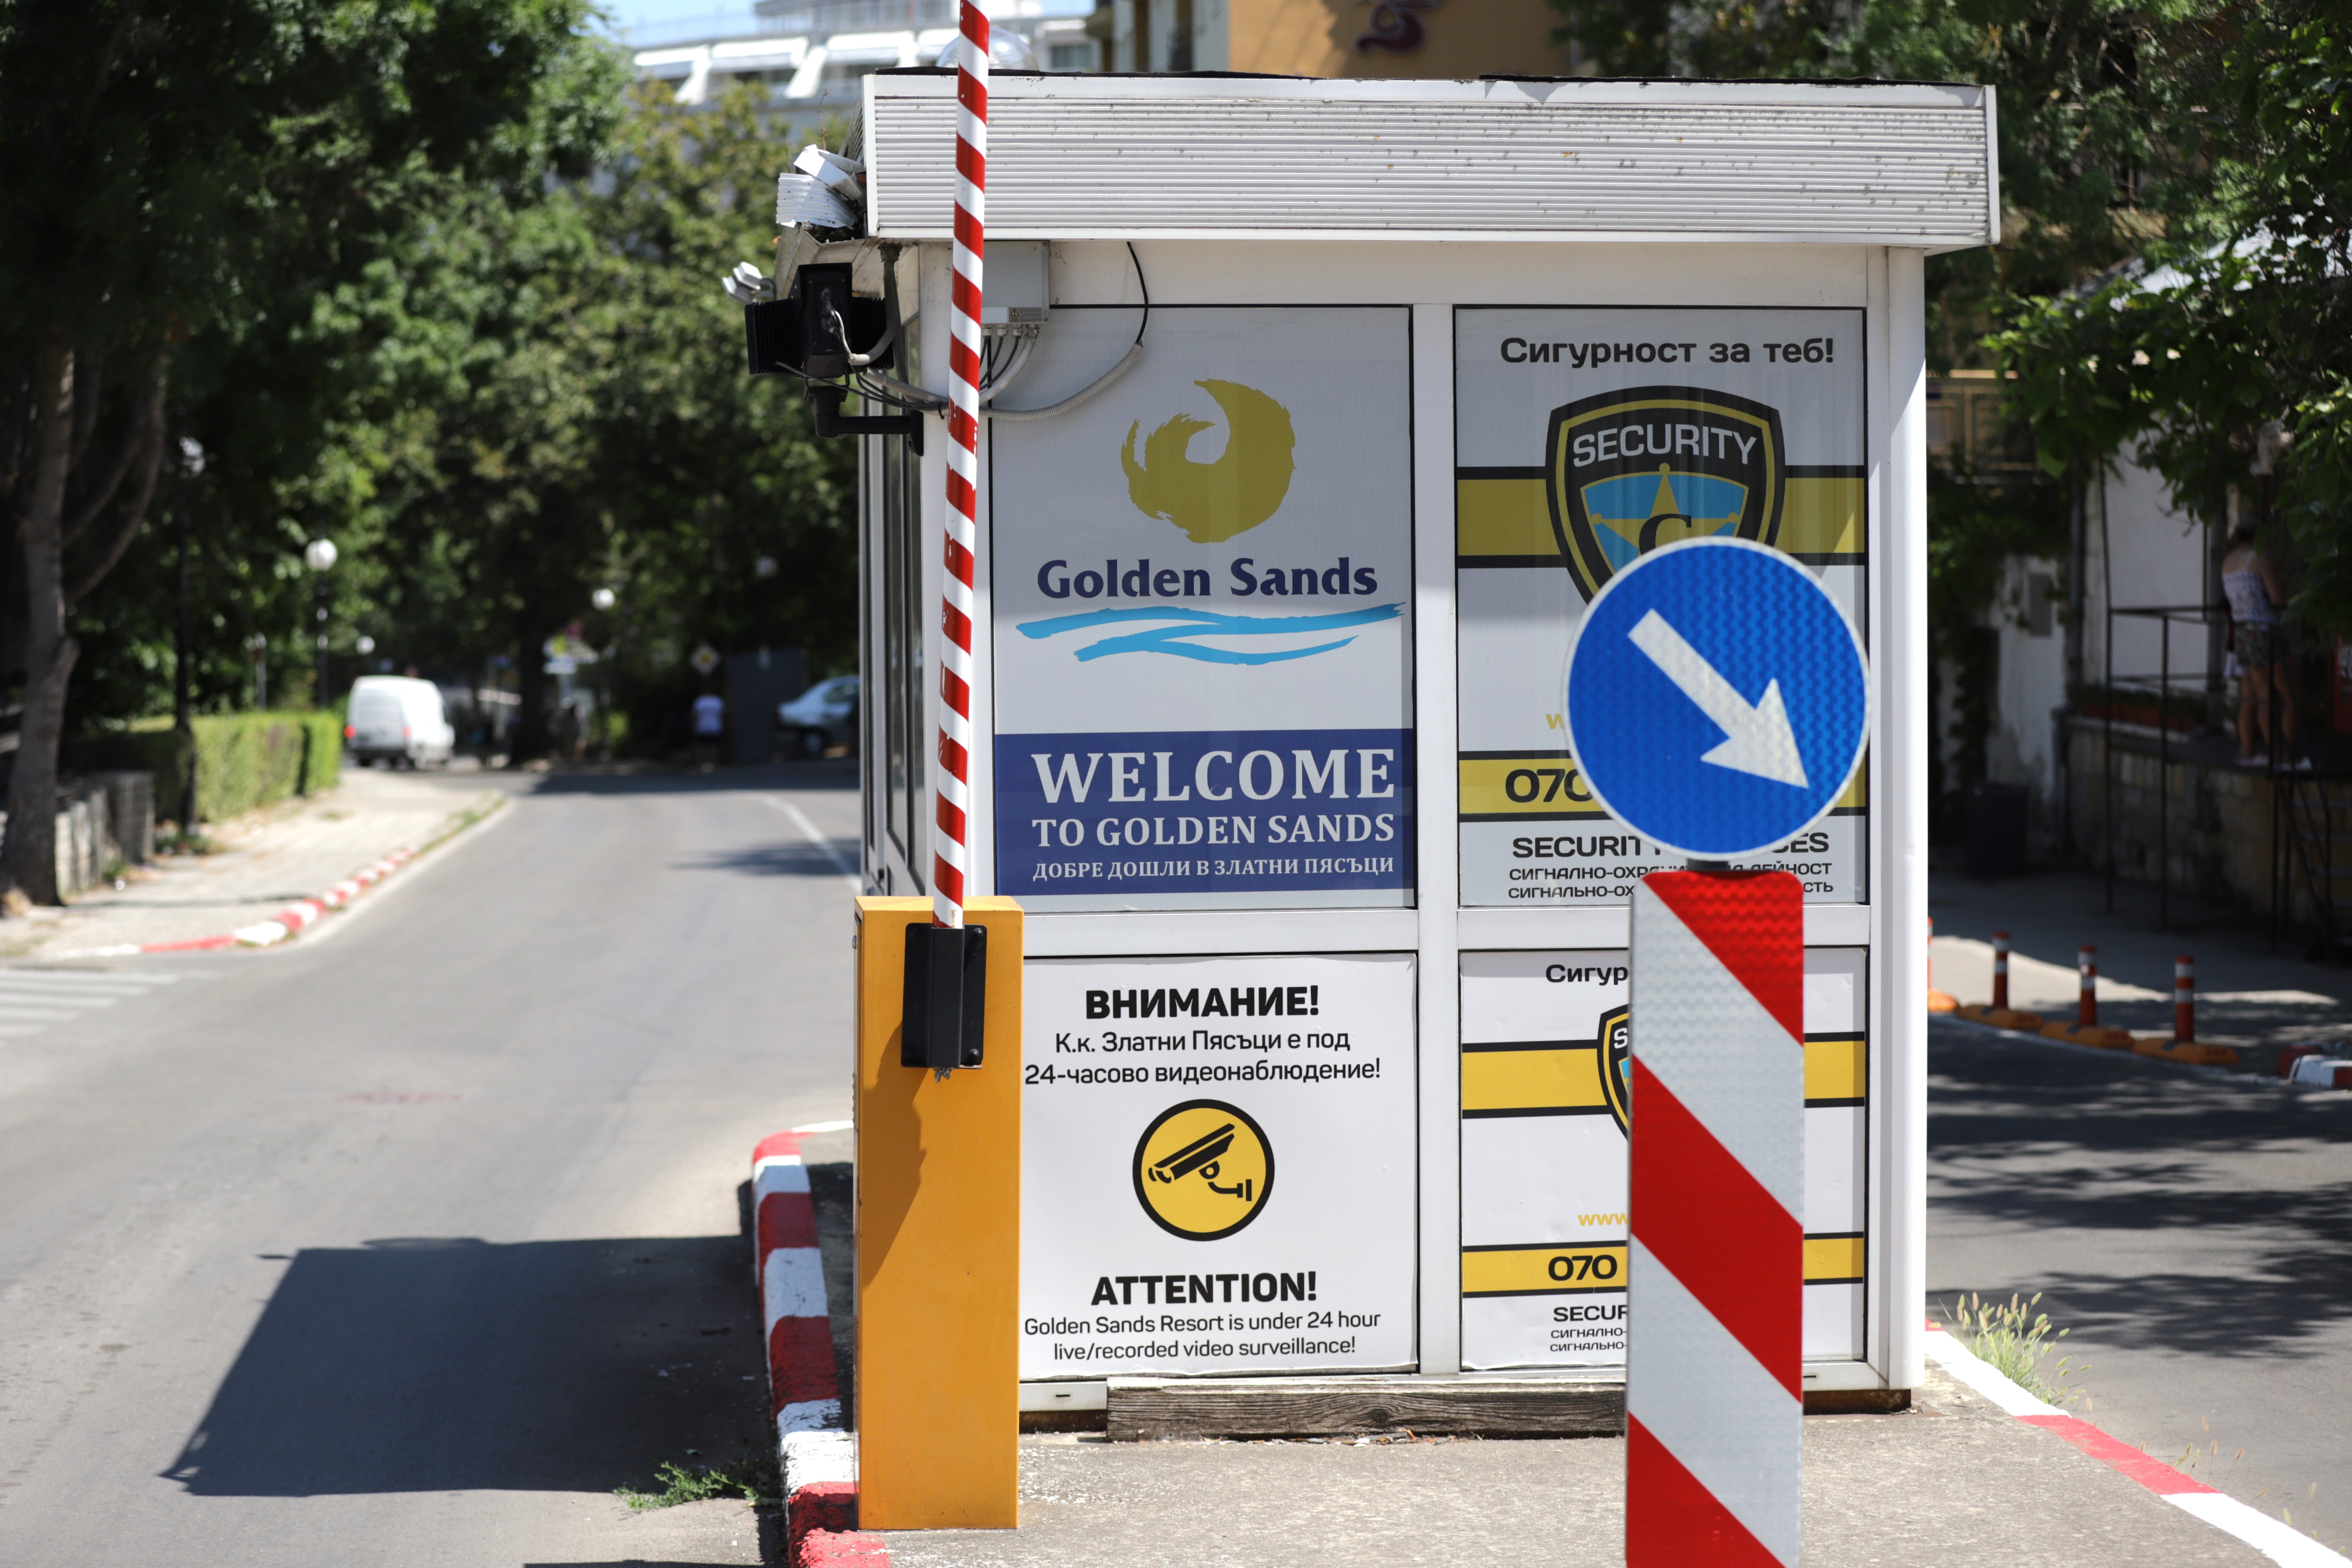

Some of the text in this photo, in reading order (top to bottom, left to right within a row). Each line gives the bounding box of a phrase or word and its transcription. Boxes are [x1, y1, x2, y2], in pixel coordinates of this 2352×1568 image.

[1501, 338, 1833, 368] Сигурност за теб!
[1573, 424, 1757, 467] SECURITY
[1038, 557, 1377, 598] Golden Sands
[1031, 749, 1394, 803] WELCOME
[1032, 813, 1393, 846] TO GOLDEN SANDS
[1513, 836, 1660, 858] SECURIT
[1033, 858, 1393, 881] ДОБРЕ ДОШЛИ В ЗЛАТНИ ПЯСЪЦИ
[1509, 886, 1634, 898] СИГНАЛЬНО-ОХ
[1546, 964, 1628, 985] Сигур
[1086, 985, 1318, 1019] ВНИМАНИЕ!
[1056, 1031, 1350, 1053] К.к. Златни Пясъци е под
[1026, 1058, 1380, 1085] 24-часово видеонаблюдение!
[1548, 1254, 1617, 1280] 070
[1091, 1271, 1316, 1305] ATTENTION!
[1025, 1311, 1380, 1335] Golden Sands Resort is under 24 hour
[1553, 1305, 1627, 1321] SECUR
[1055, 1336, 1355, 1360] live/recorded video surveillance!
